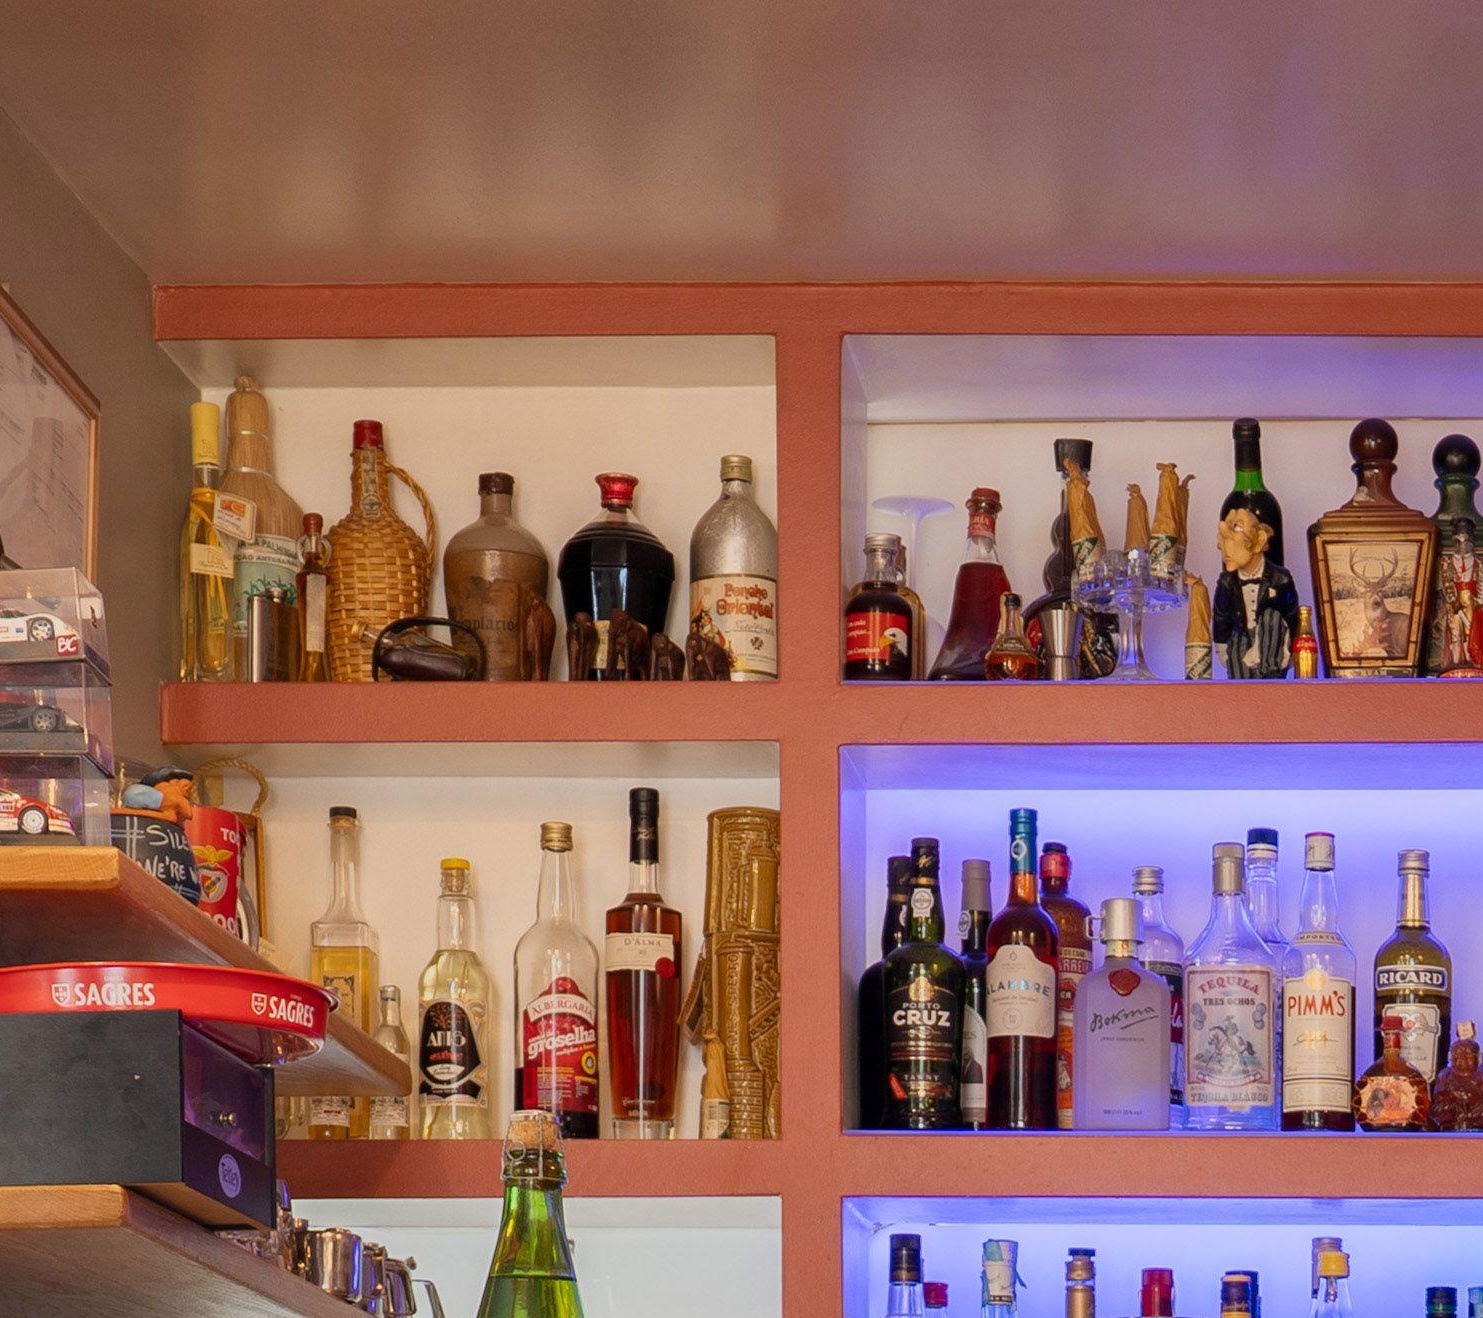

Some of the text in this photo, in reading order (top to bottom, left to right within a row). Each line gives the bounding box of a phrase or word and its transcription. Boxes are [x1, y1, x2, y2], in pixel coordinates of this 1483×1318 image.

[1197, 976, 1260, 995] TEQUILA
[1379, 971, 1443, 986] RICARD
[74, 983, 155, 1007] SAGRES
[1288, 991, 1346, 1017] PIMM'S
[269, 995, 314, 1028] SAGRES
[531, 1000, 594, 1018] ALBERGARIA
[902, 1002, 940, 1010] PORTO
[892, 1010, 951, 1027] CRUZ
[528, 1027, 596, 1060] groselha
